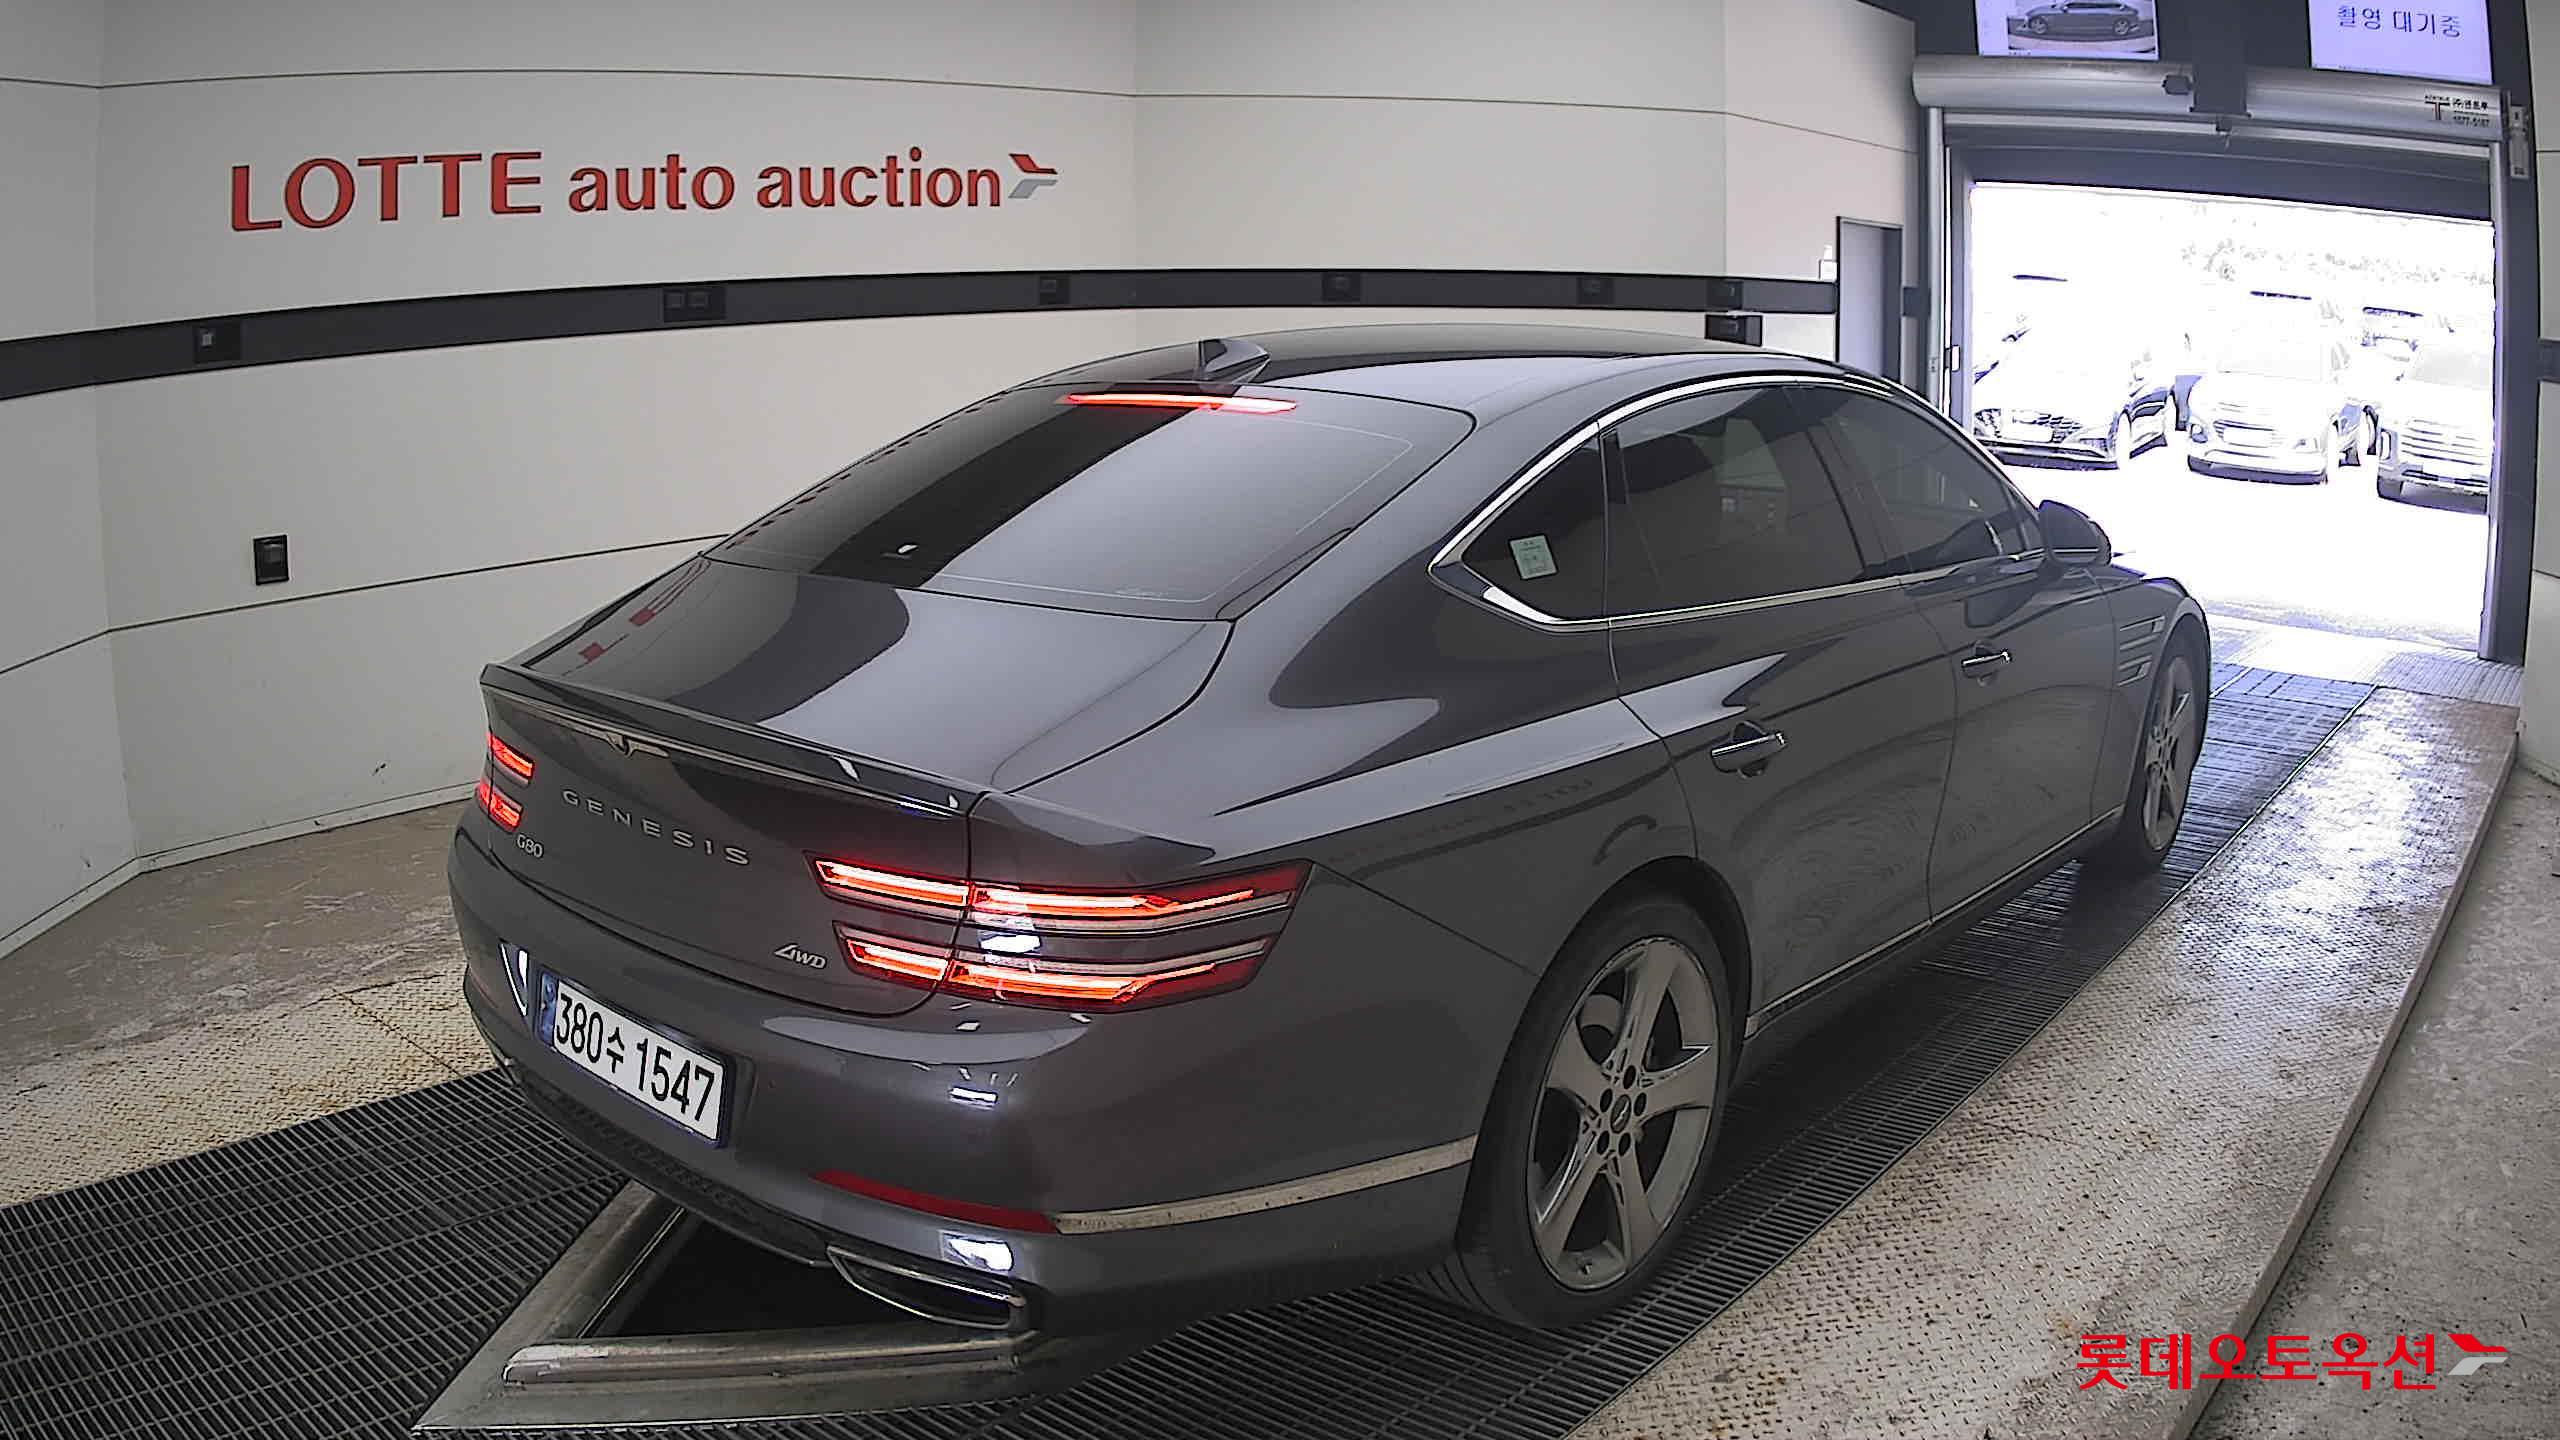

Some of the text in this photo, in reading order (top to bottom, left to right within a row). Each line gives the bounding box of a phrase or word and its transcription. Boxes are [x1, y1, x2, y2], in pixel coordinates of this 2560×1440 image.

[2337, 4, 2461, 38] 촬영 대기중
[231, 146, 1000, 232] LOTTE auto auction
[517, 833, 543, 858] G80
[562, 790, 749, 866] GENESIS
[774, 943, 827, 969] 4WD
[636, 1037, 715, 1122] 1547
